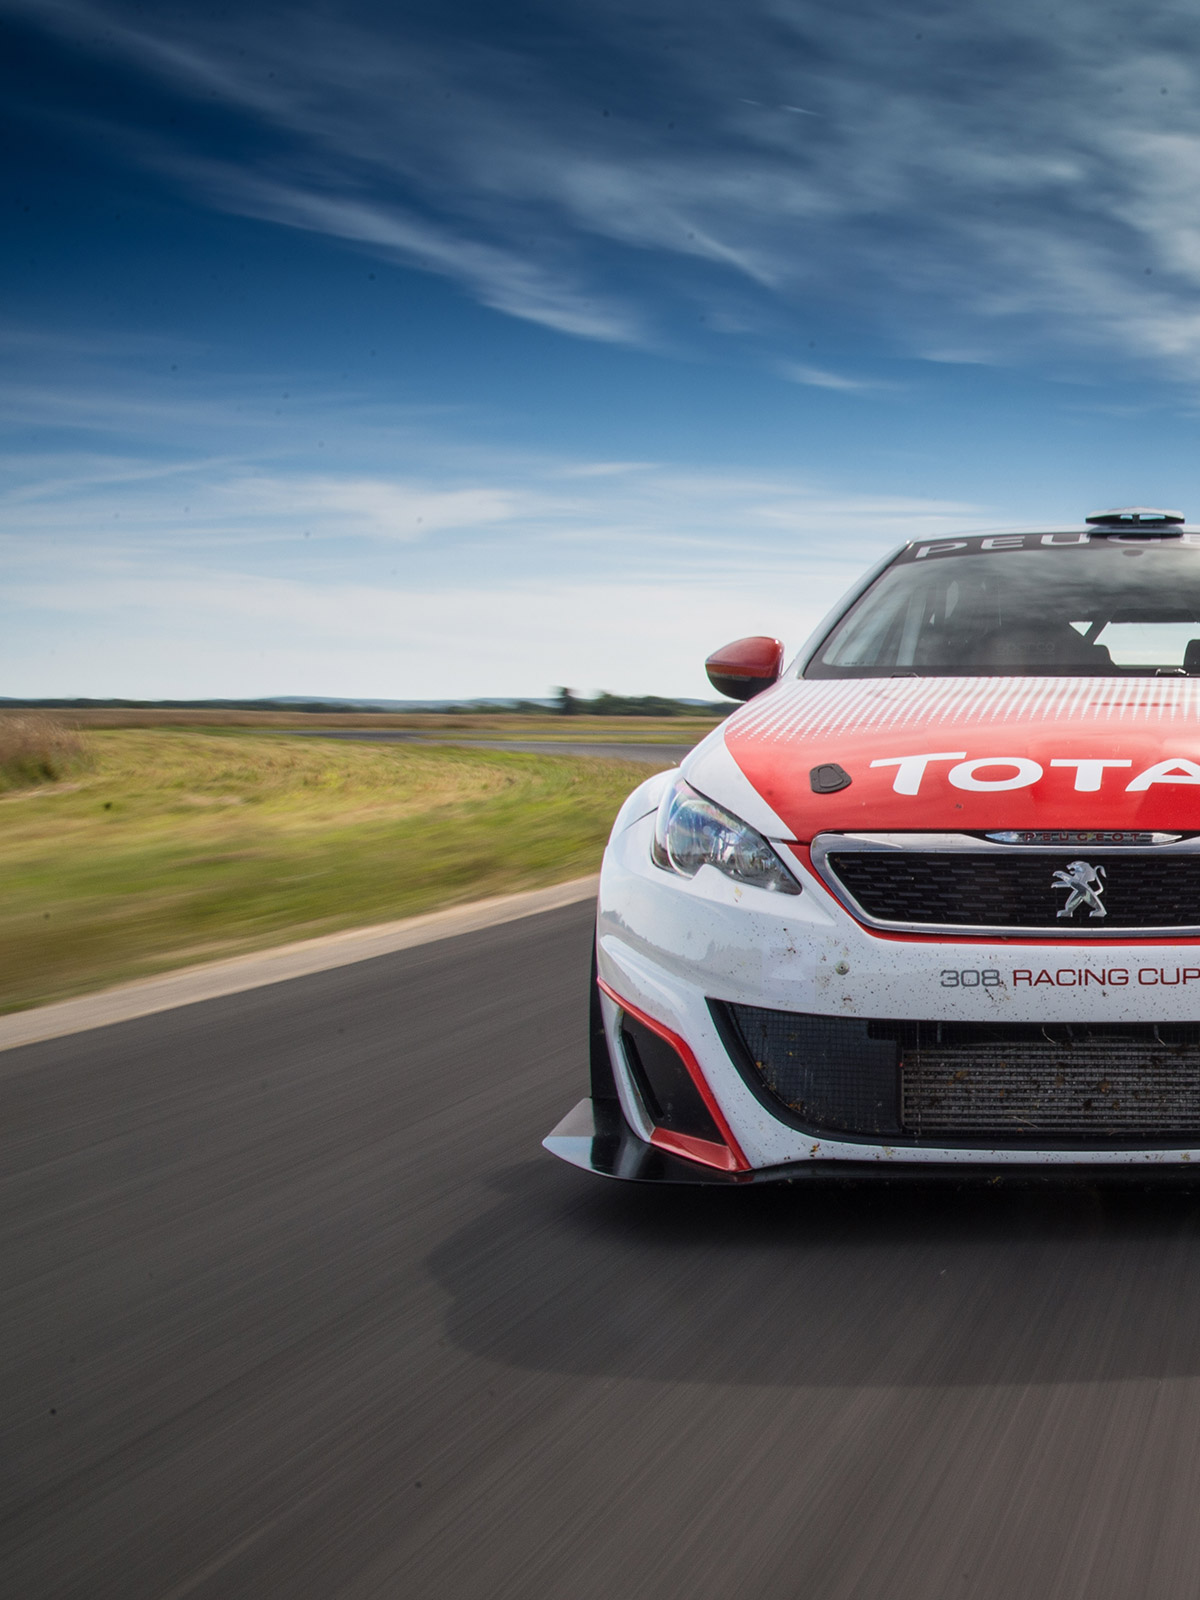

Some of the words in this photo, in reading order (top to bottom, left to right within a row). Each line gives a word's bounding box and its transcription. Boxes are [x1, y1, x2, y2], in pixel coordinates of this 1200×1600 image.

[1024, 832, 1141, 841] PEUGEOT
[940, 969, 1000, 987] 308
[1012, 968, 1129, 986] RACING
